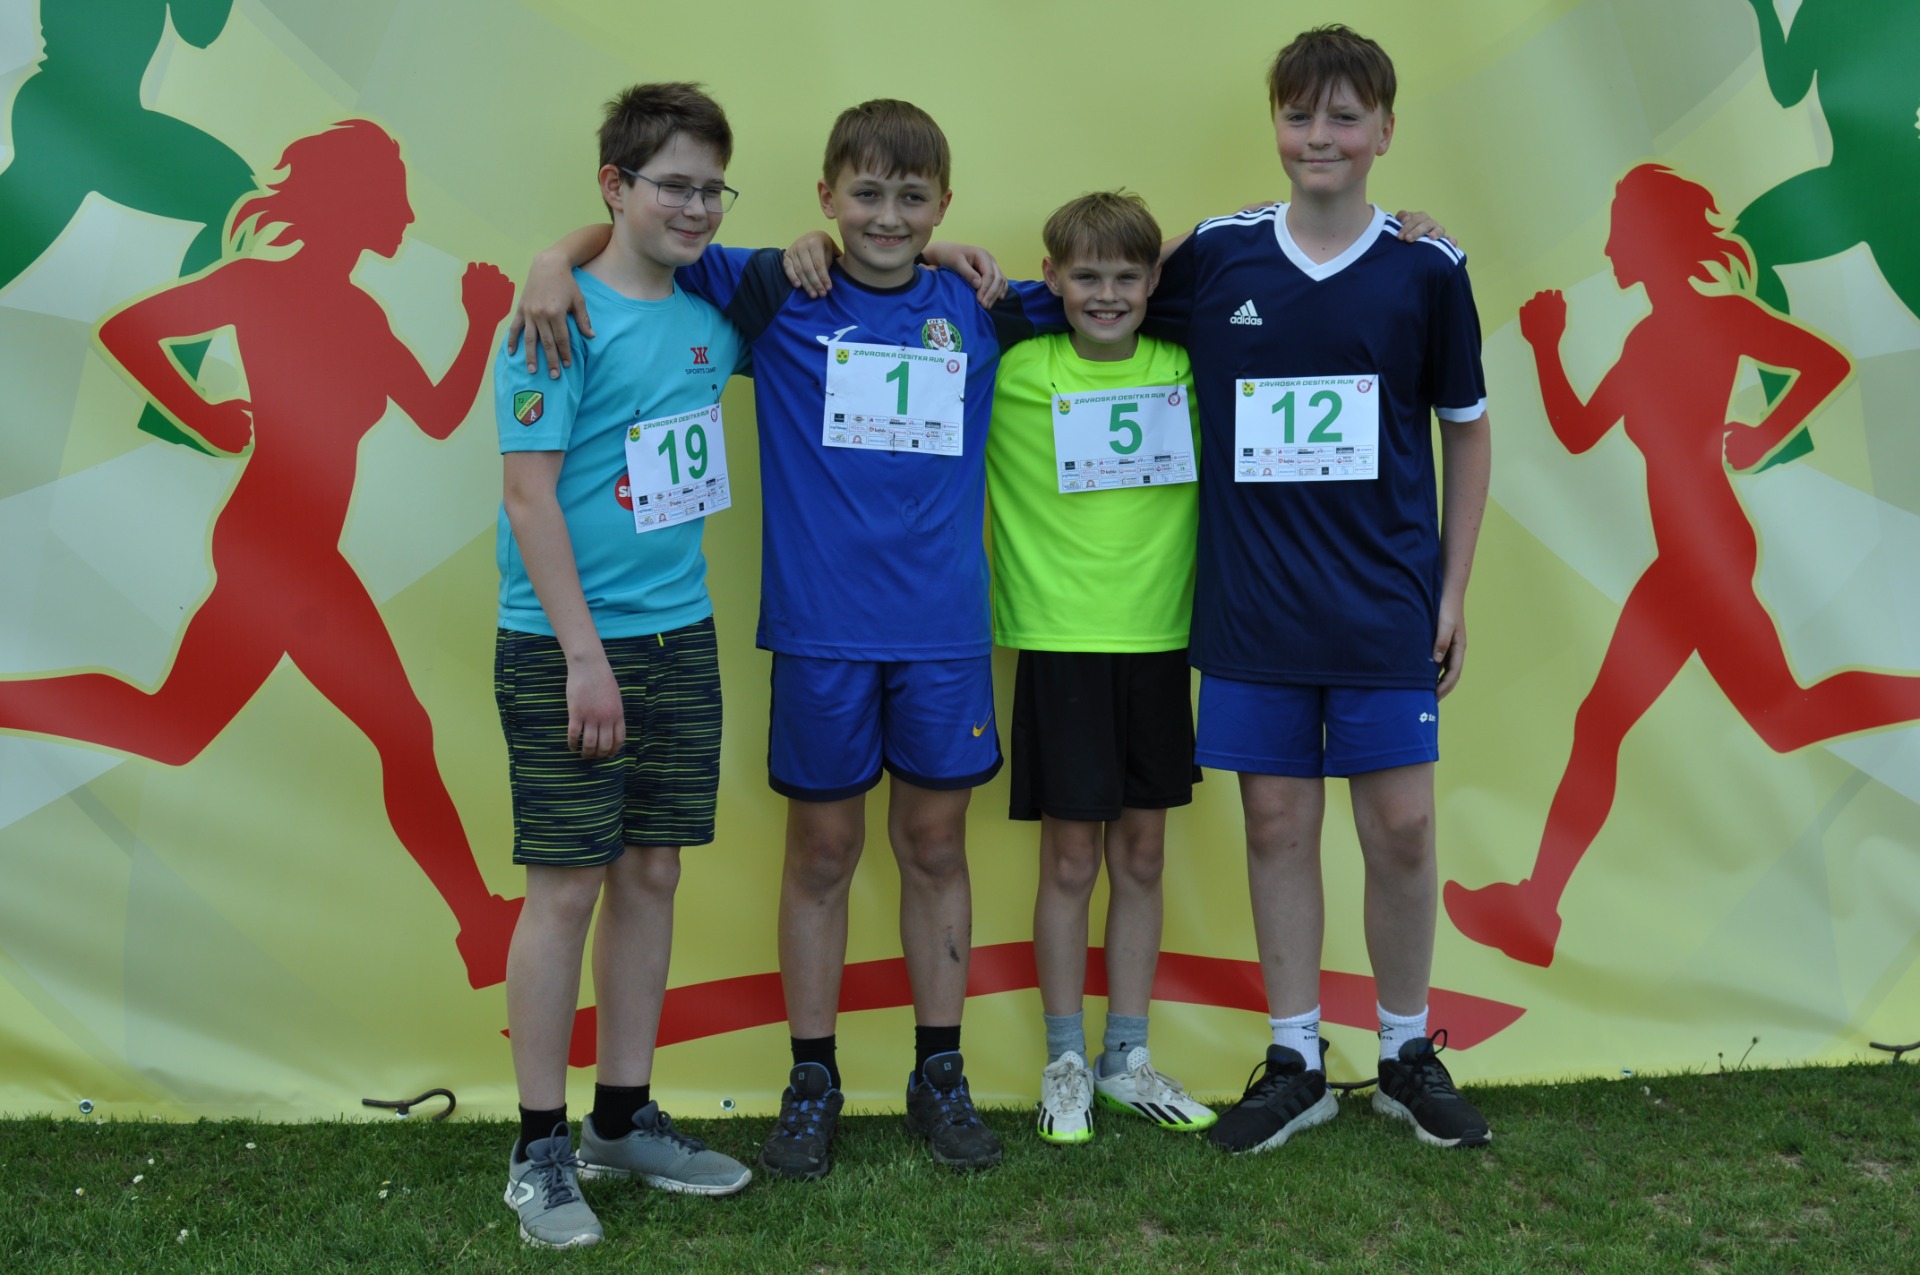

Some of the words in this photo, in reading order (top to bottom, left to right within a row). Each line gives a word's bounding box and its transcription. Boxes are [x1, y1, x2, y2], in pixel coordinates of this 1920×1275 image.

[1230, 314, 1262, 325] adidas
[886, 361, 909, 415] 1
[1109, 402, 1143, 455] 5
[1271, 390, 1343, 444] 12
[658, 424, 707, 485] 19
